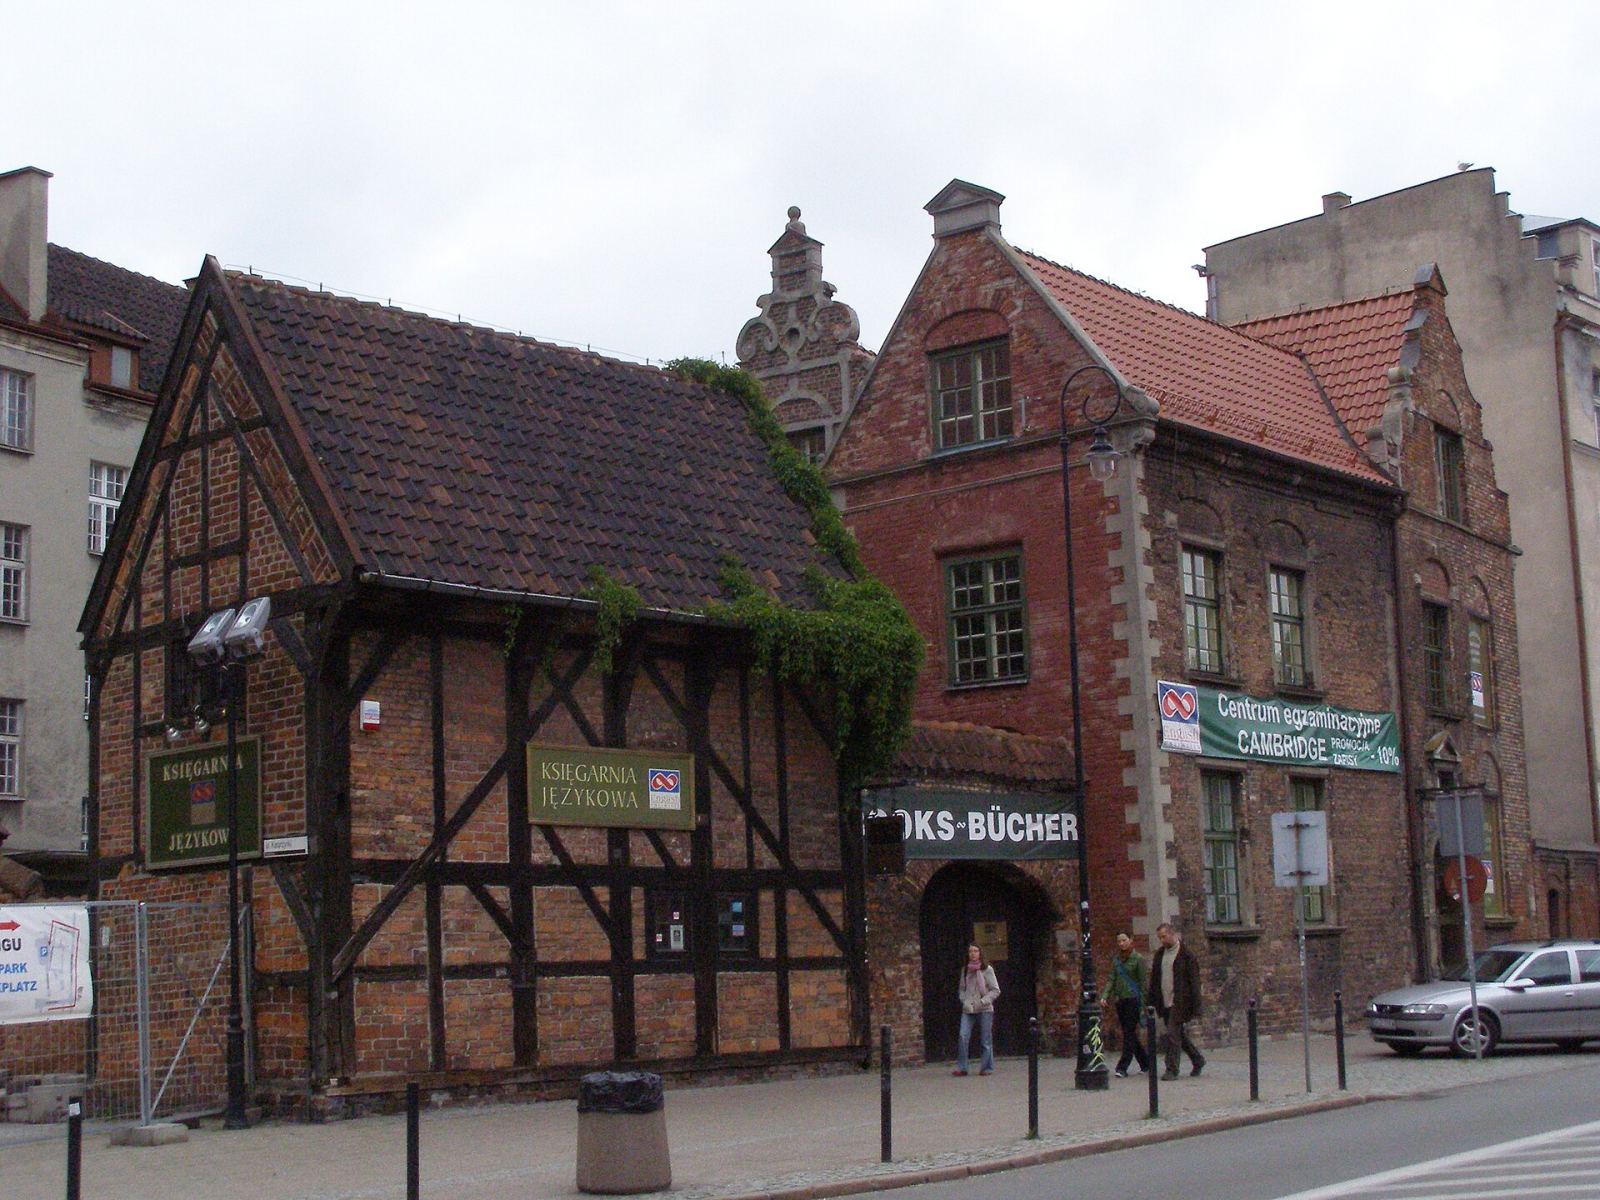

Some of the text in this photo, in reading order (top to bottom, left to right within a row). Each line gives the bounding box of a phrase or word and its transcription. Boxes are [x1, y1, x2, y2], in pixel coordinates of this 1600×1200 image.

[1217, 693, 1381, 738] Centrum egzaminacyjne
[1238, 730, 1328, 761] CAMBRIDGE
[1331, 737, 1370, 752] PROMOCJA
[163, 753, 243, 782] KSIĘGARNA
[541, 762, 637, 786] KSIĘGARNIA
[542, 786, 639, 809] JĘZYKOWA
[968, 805, 1079, 841] BÜCHER
[169, 828, 230, 853] JĘZYKOW
[0, 938, 21, 952] GU
